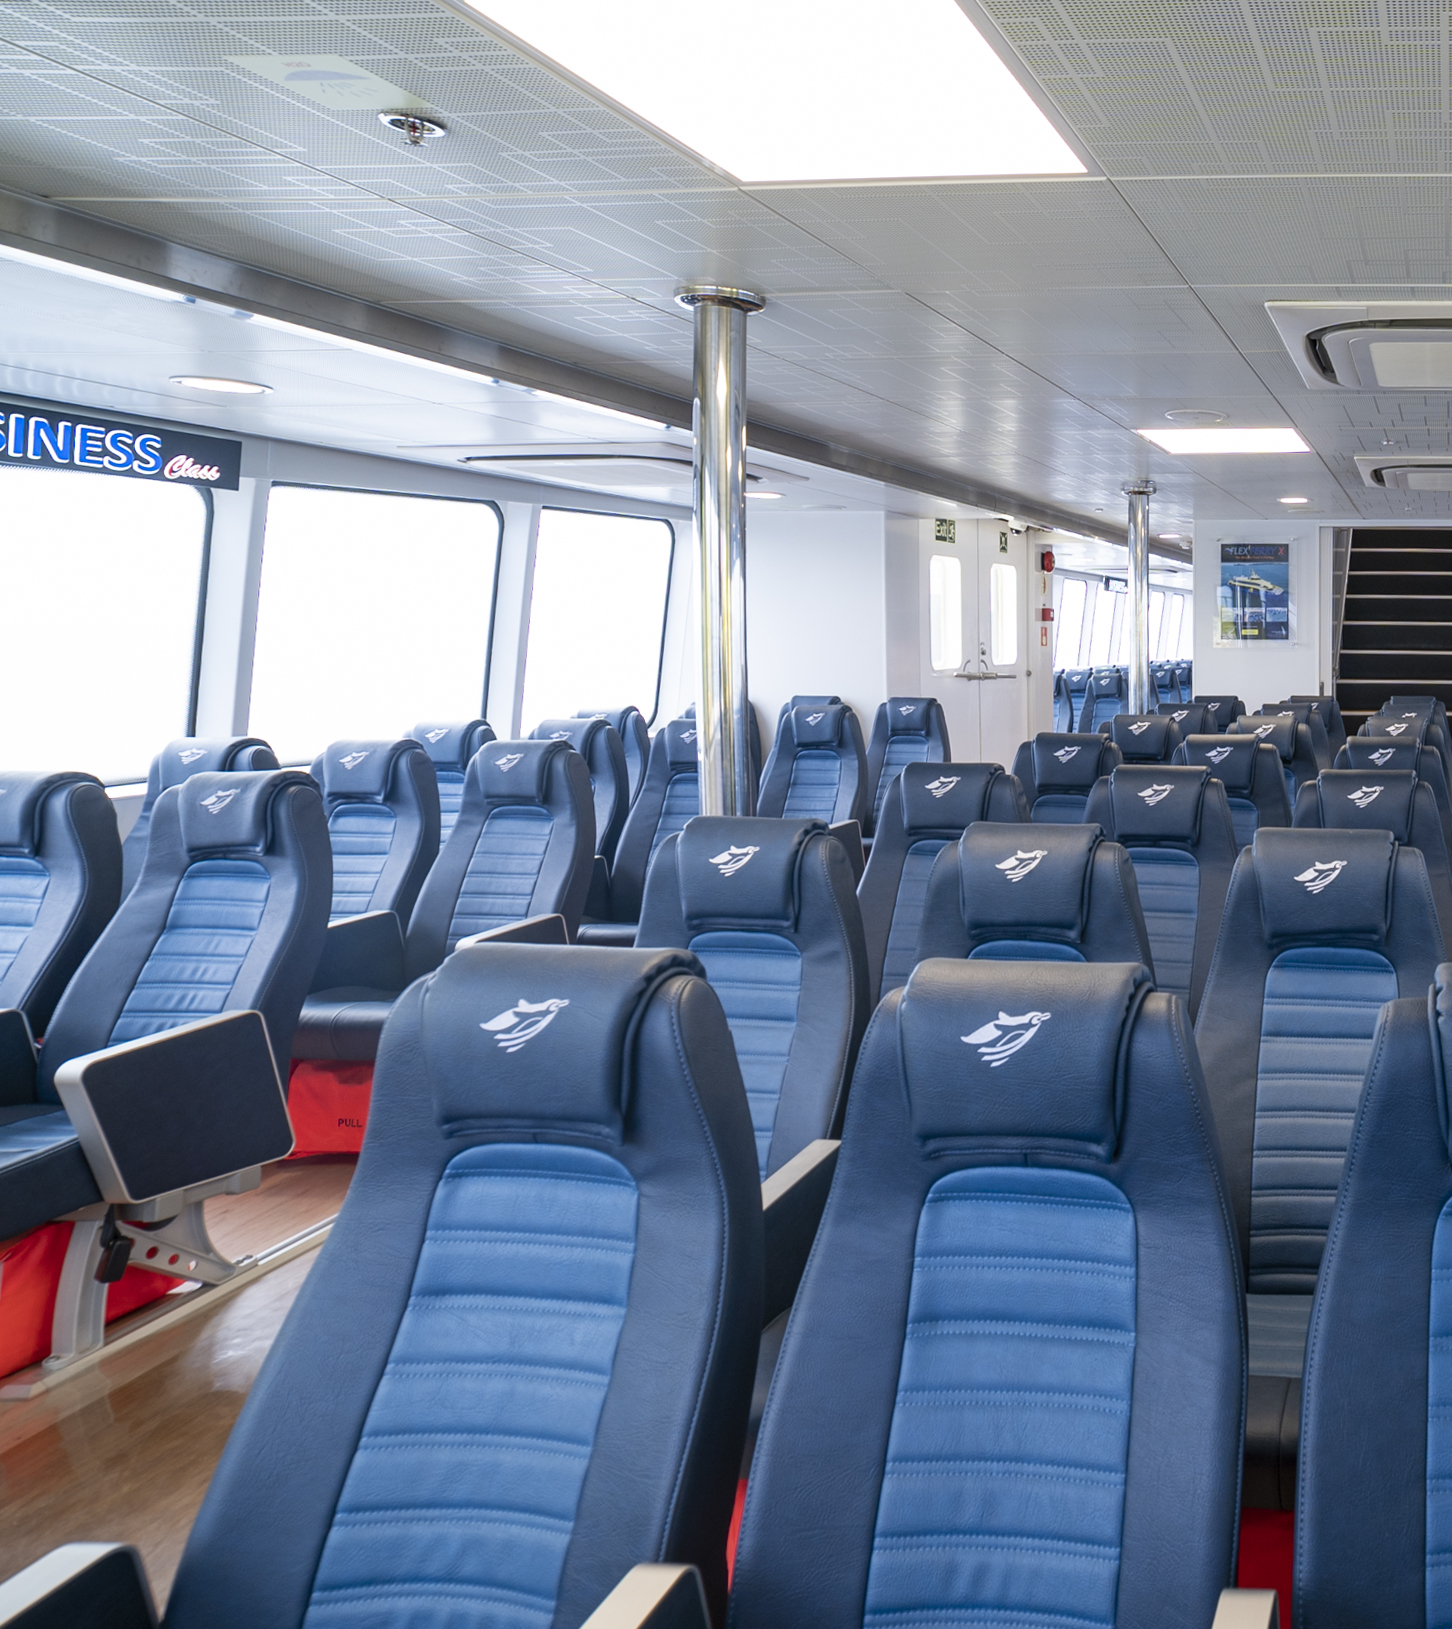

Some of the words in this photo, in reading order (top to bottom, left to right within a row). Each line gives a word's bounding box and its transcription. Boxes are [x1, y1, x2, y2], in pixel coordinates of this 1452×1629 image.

[0, 412, 163, 475] INESS
[163, 455, 221, 481] Class
[936, 520, 947, 537] Exit
[1249, 547, 1277, 555] FERRY
[1278, 547, 1285, 555] X
[338, 1118, 362, 1128] PULL
